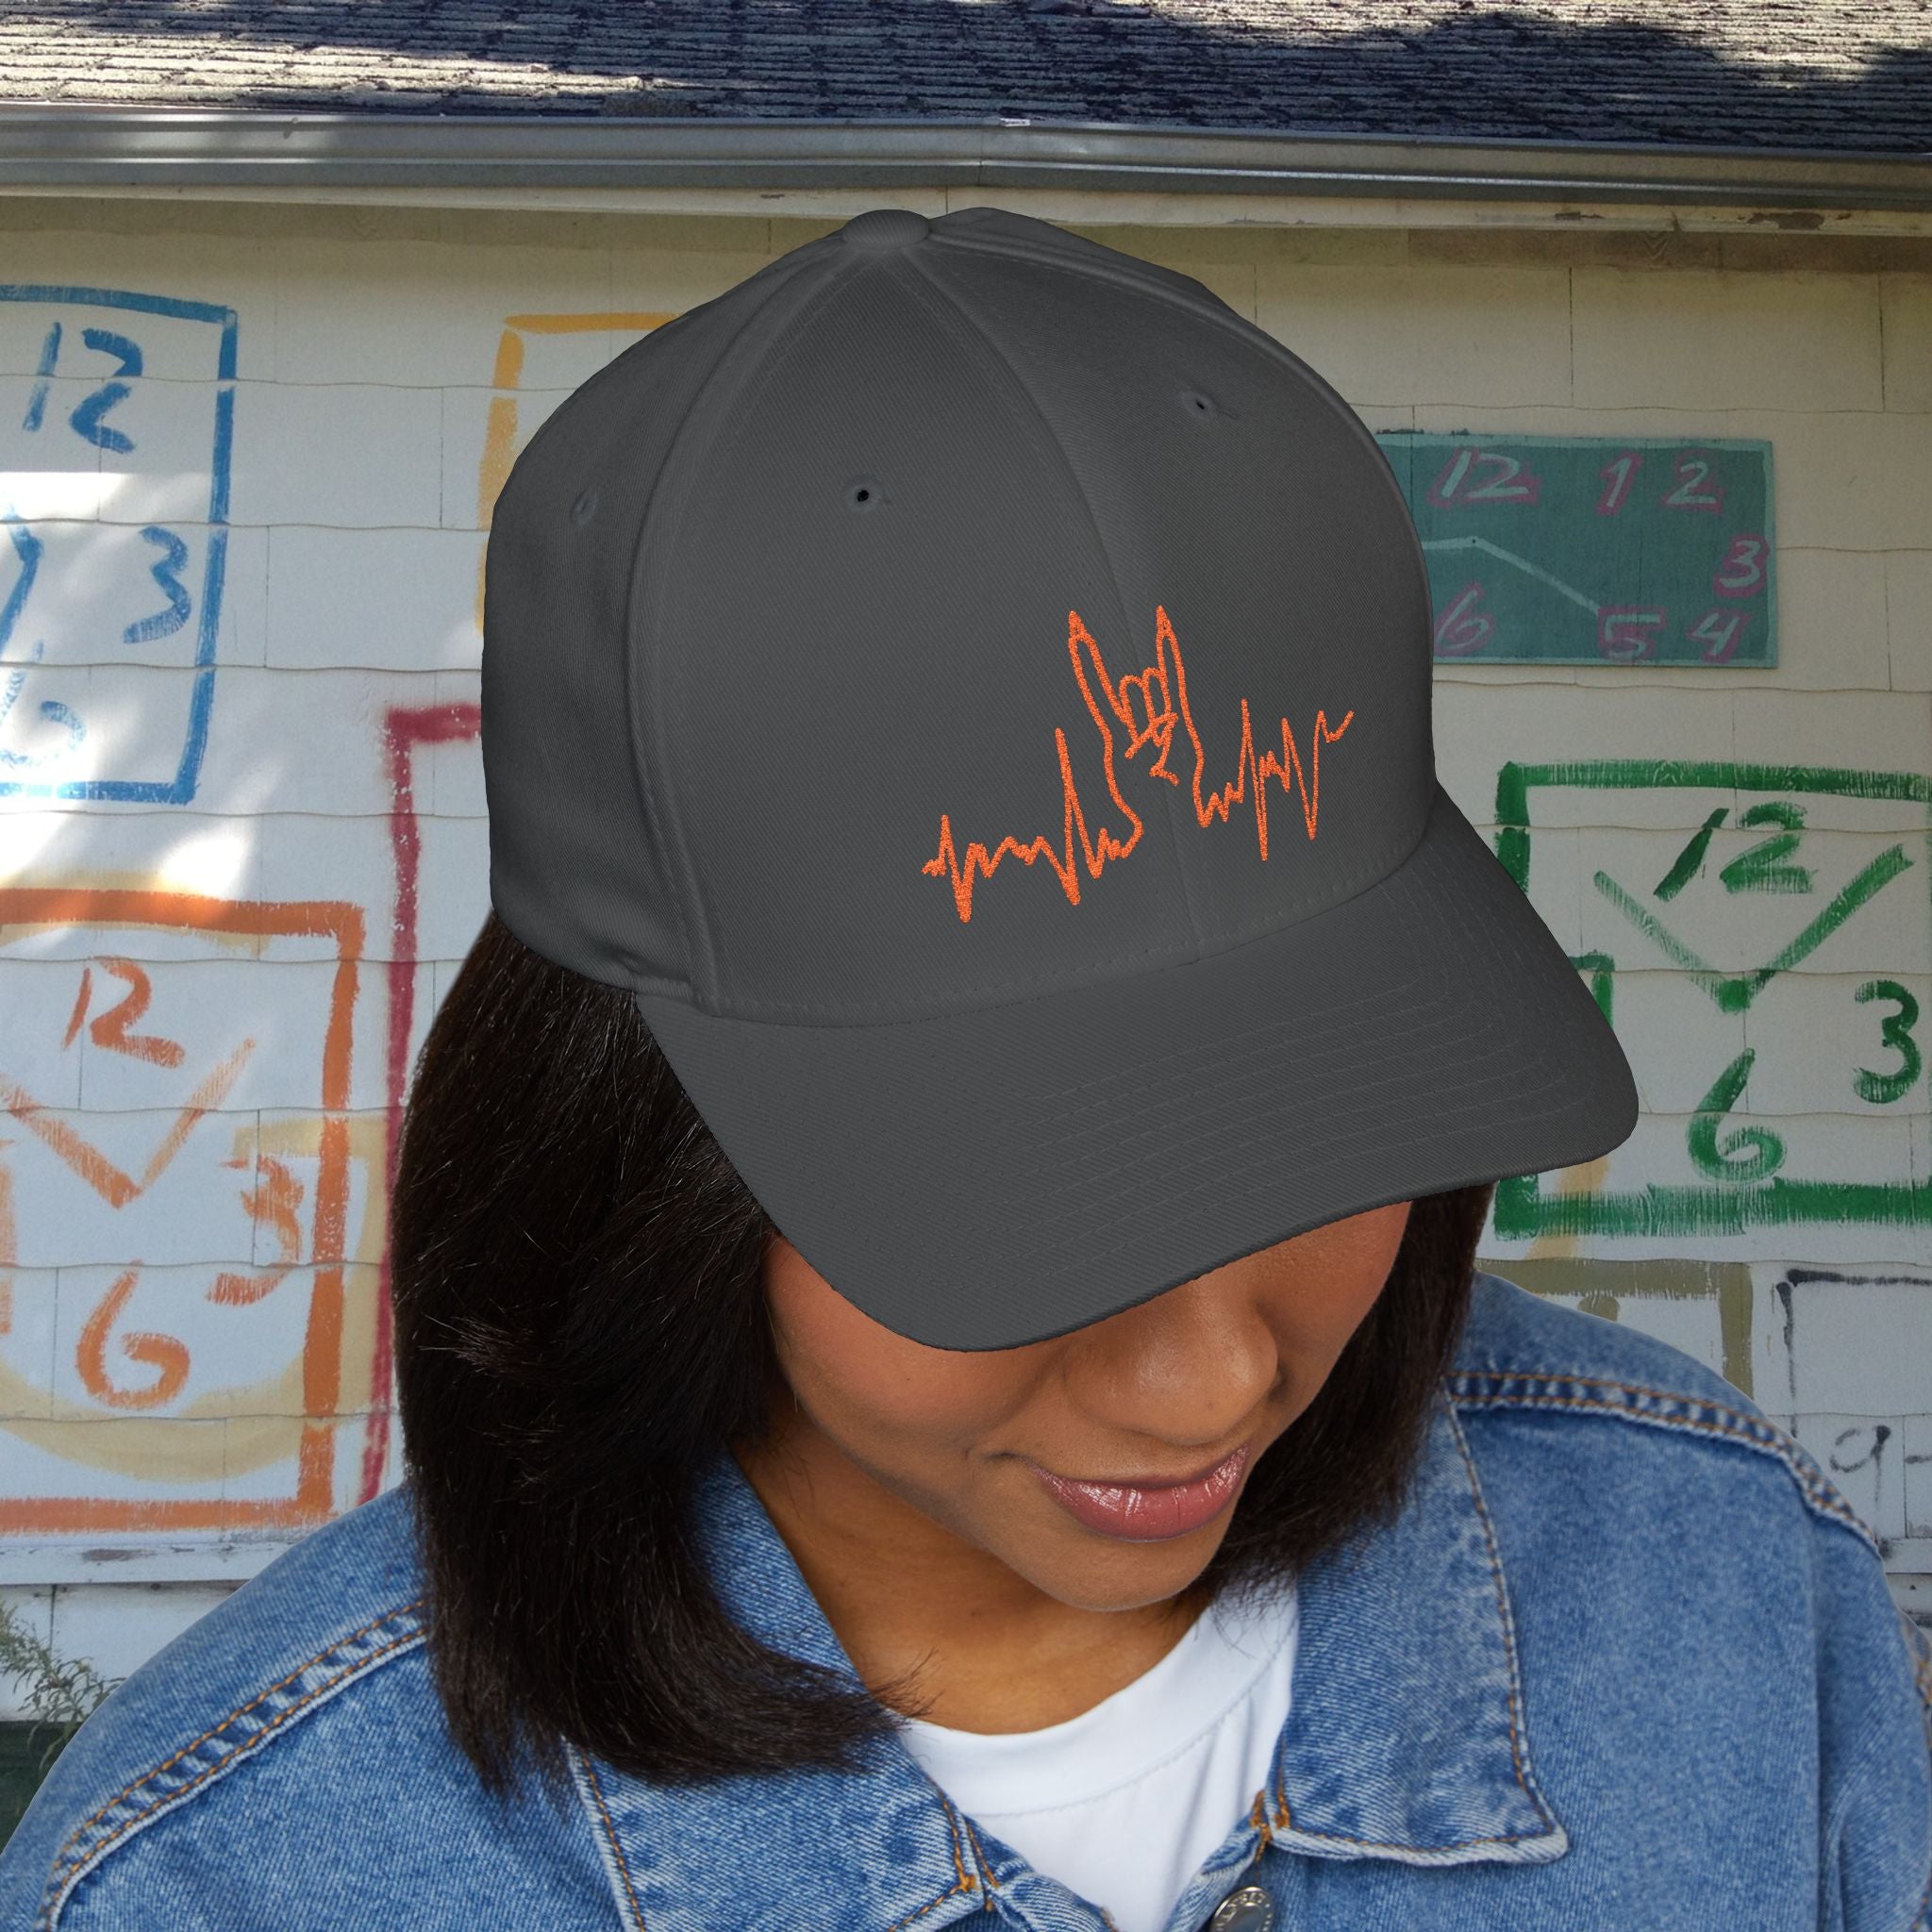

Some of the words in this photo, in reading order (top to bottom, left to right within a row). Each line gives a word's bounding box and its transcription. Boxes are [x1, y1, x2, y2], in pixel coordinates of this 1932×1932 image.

[23, 322, 143, 454] 12
[1432, 447, 1538, 503] 12
[1600, 453, 1639, 512] 1
[1663, 454, 1722, 510] 2
[123, 525, 192, 644] 3
[1434, 585, 1491, 653] 6
[1601, 608, 1664, 660] 5
[1689, 609, 1744, 659] 4
[1716, 536, 1767, 593] 3
[1653, 801, 1817, 903] 12
[62, 955, 187, 1069] 12
[1854, 979, 1923, 1104] 3
[1687, 1048, 1788, 1184] 6
[75, 1260, 191, 1410] 6
